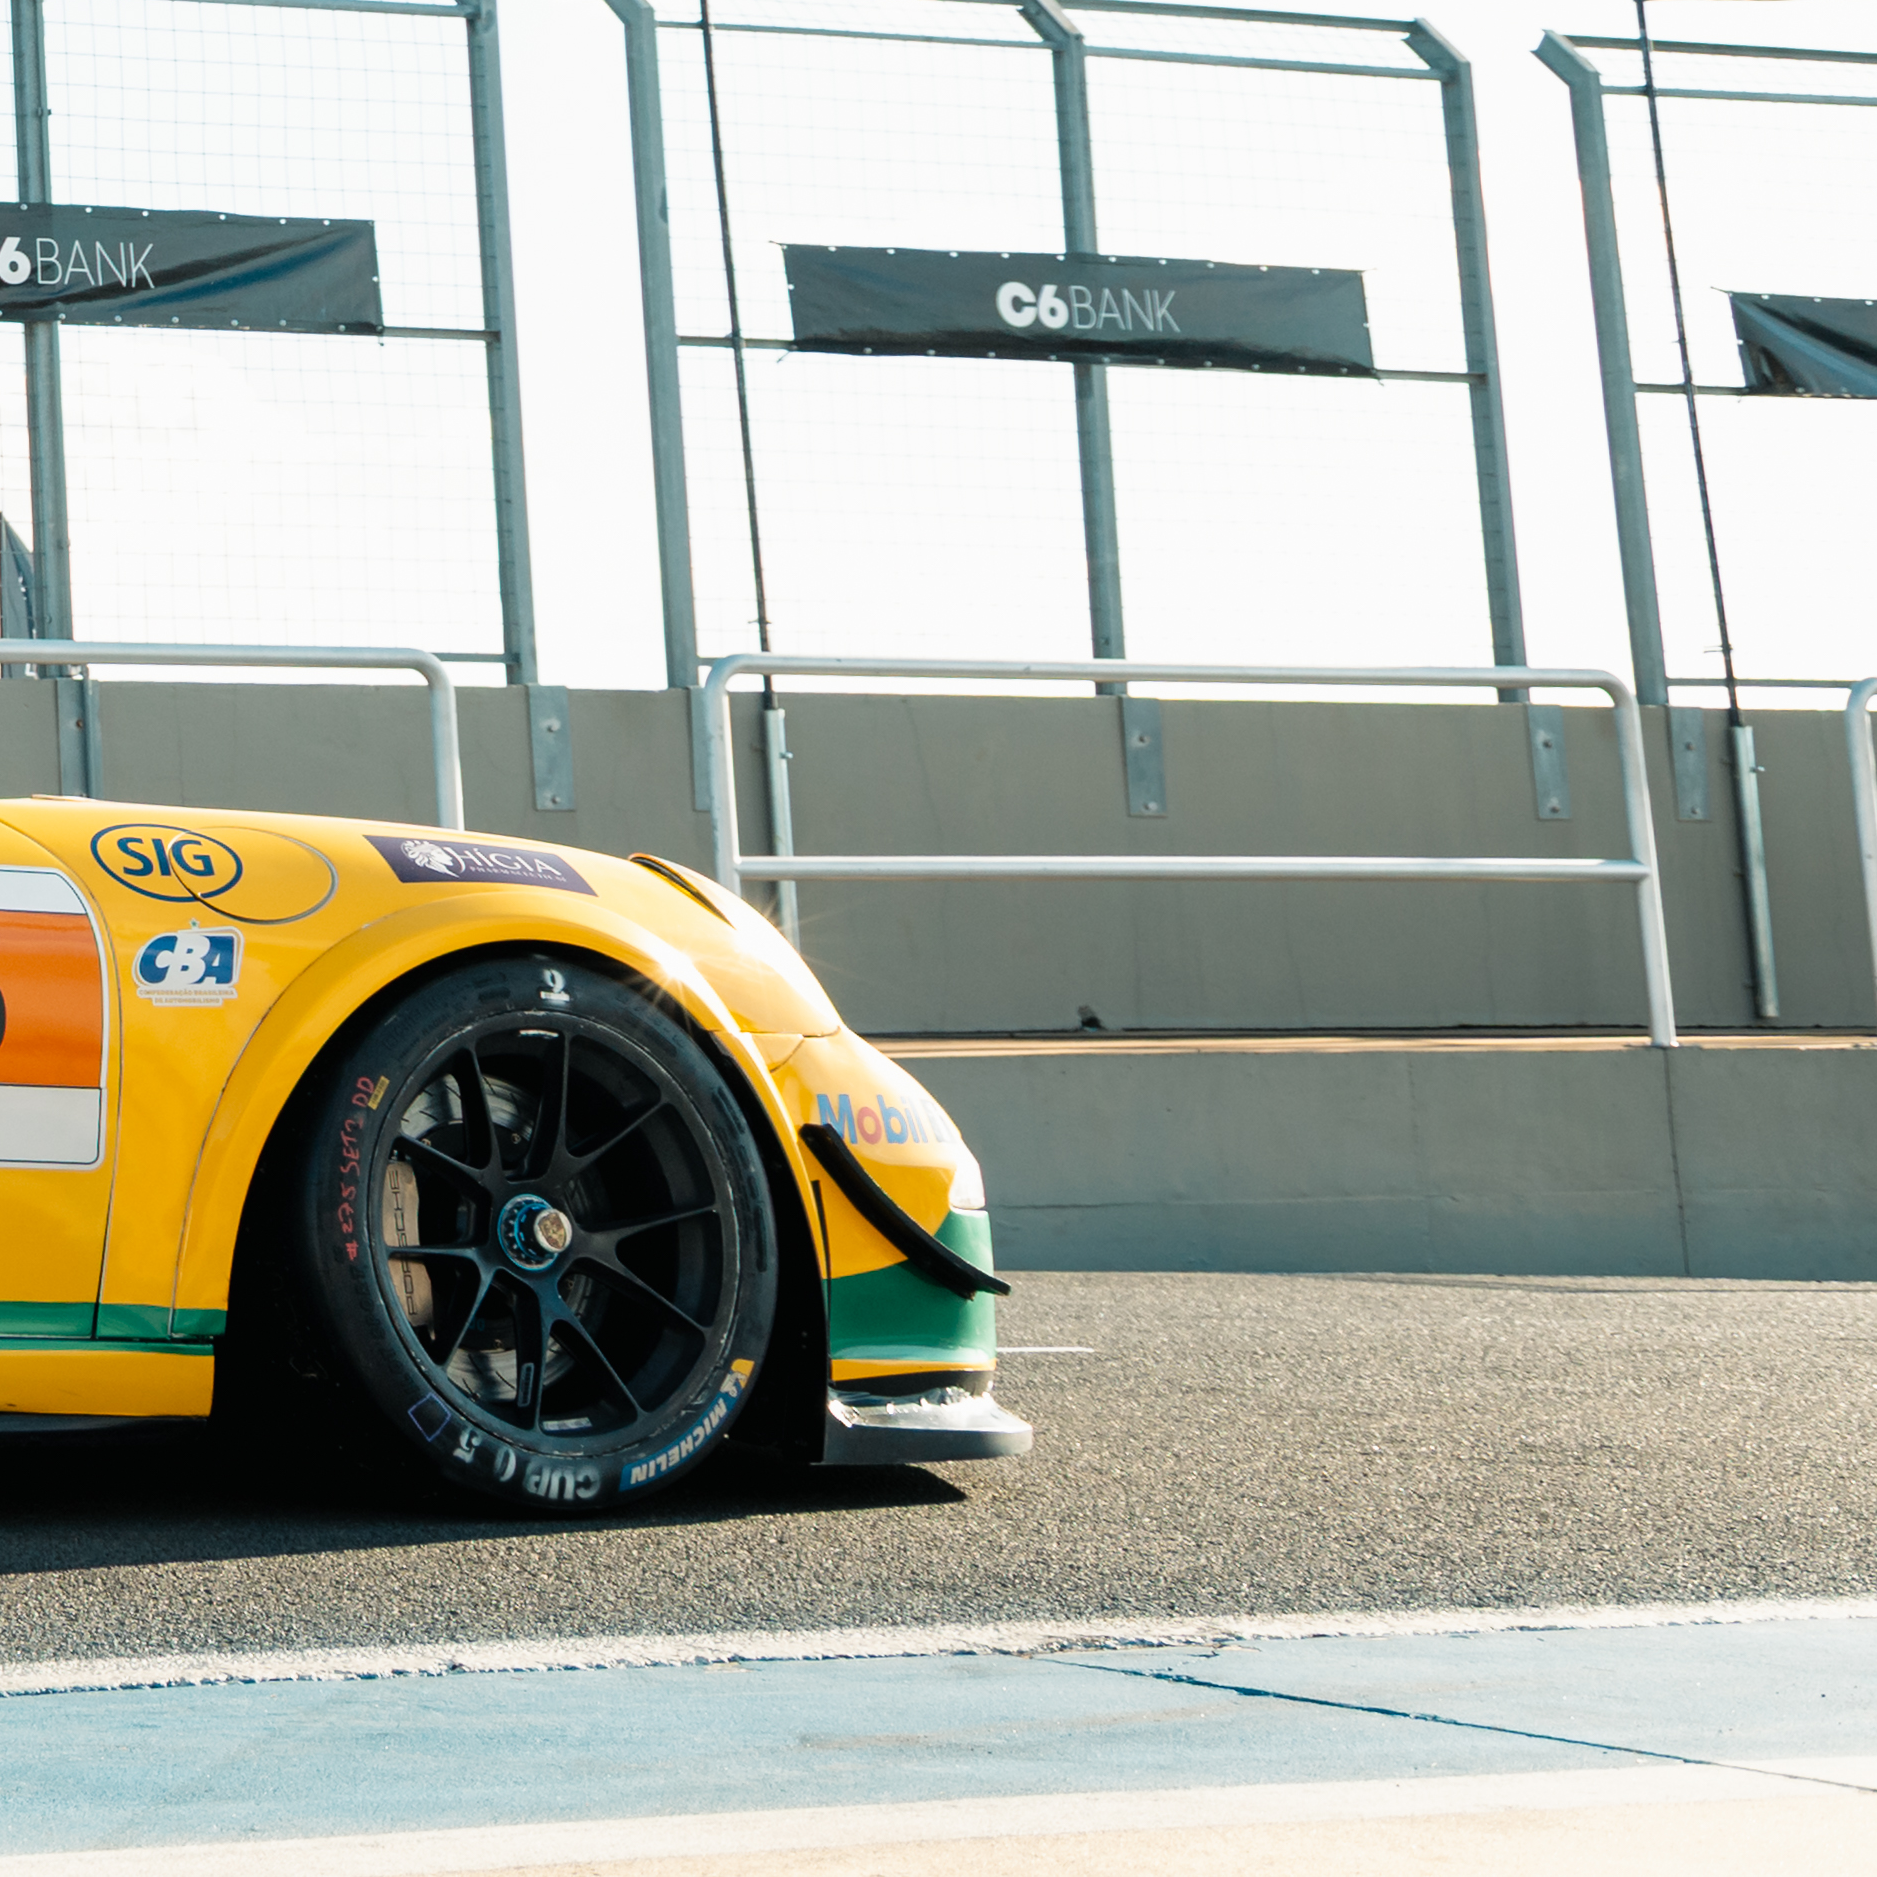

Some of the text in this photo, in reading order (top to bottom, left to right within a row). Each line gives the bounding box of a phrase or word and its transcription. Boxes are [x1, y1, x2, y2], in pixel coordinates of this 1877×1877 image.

[116, 837, 215, 877] SIG
[139, 933, 235, 985] CBA
[816, 1093, 929, 1145] Mobil
[630, 1397, 727, 1485] MICHELIN
[523, 1463, 601, 1500] CUP
